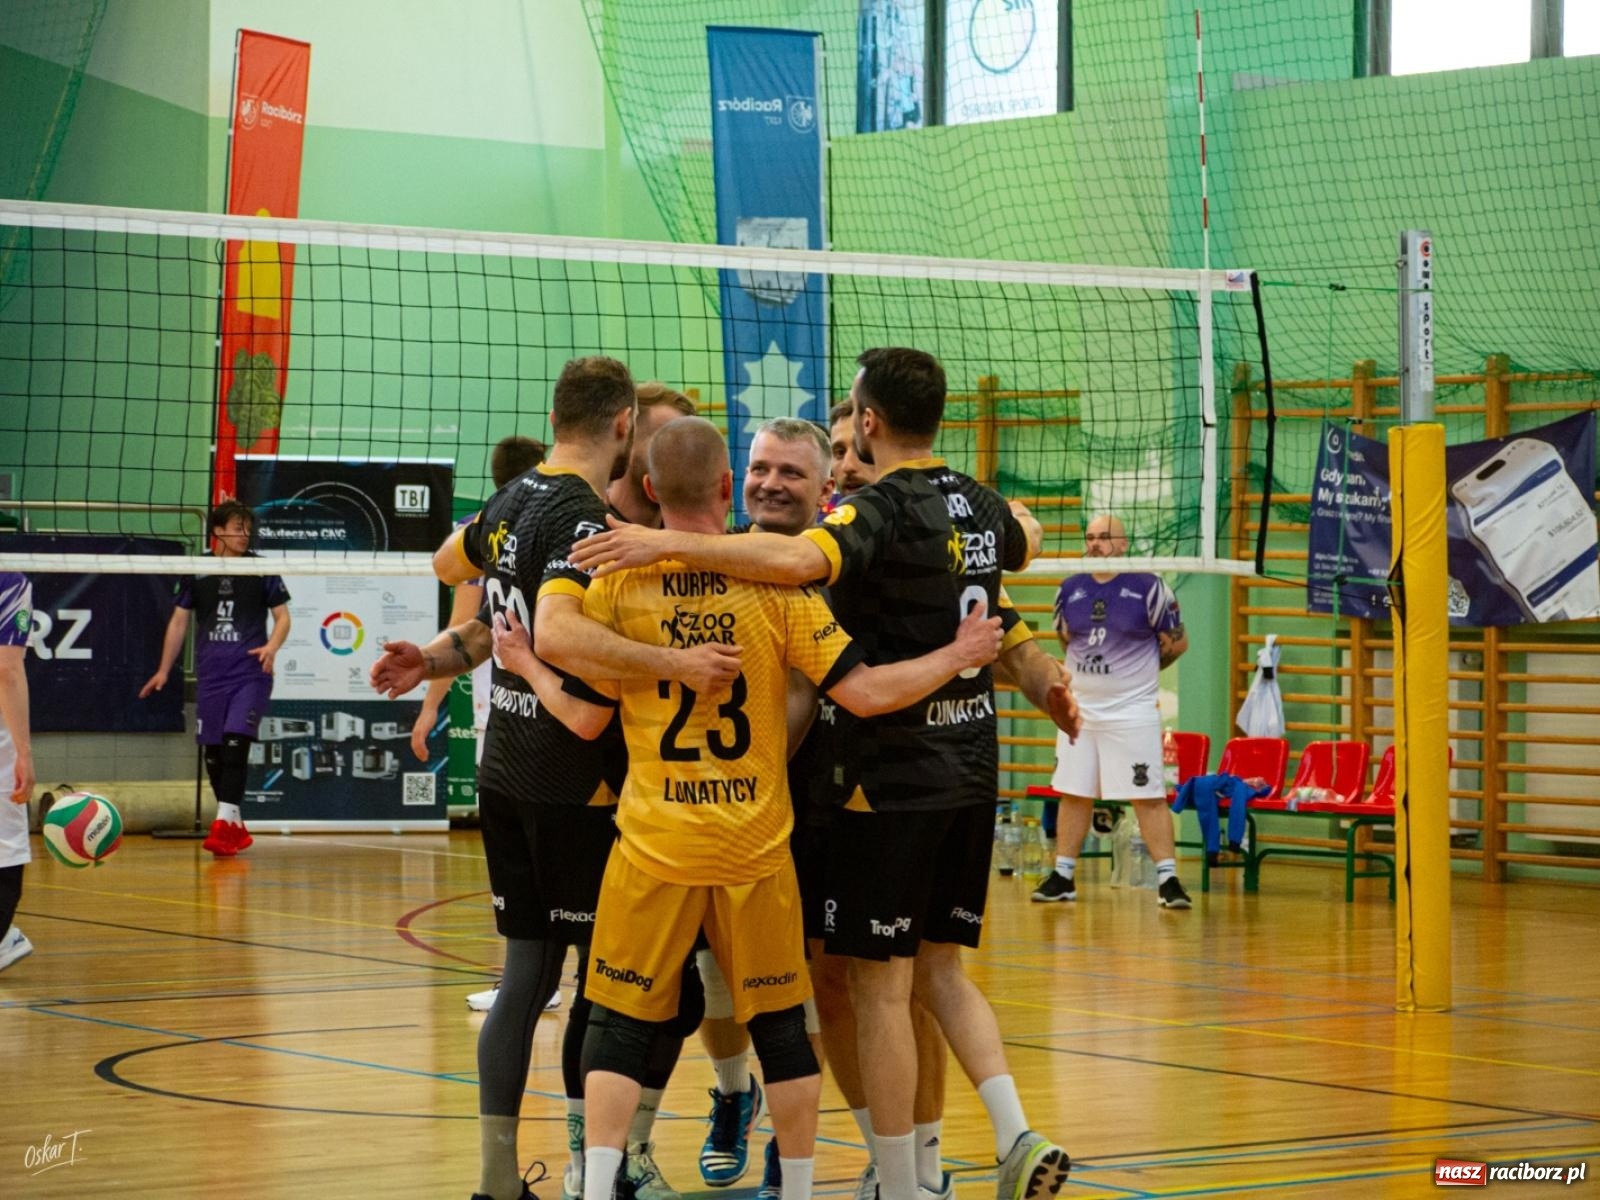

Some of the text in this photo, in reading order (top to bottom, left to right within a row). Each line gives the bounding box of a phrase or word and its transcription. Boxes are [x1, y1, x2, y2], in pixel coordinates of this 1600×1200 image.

[320, 528, 347, 541] CNC
[662, 571, 728, 597] KURPIS
[217, 600, 235, 618] 47
[688, 612, 736, 632] ZOO
[1087, 626, 1107, 647] 69
[657, 670, 752, 762] 23
[664, 777, 758, 805] LUNATYCY
[595, 957, 654, 992] TropiDog
